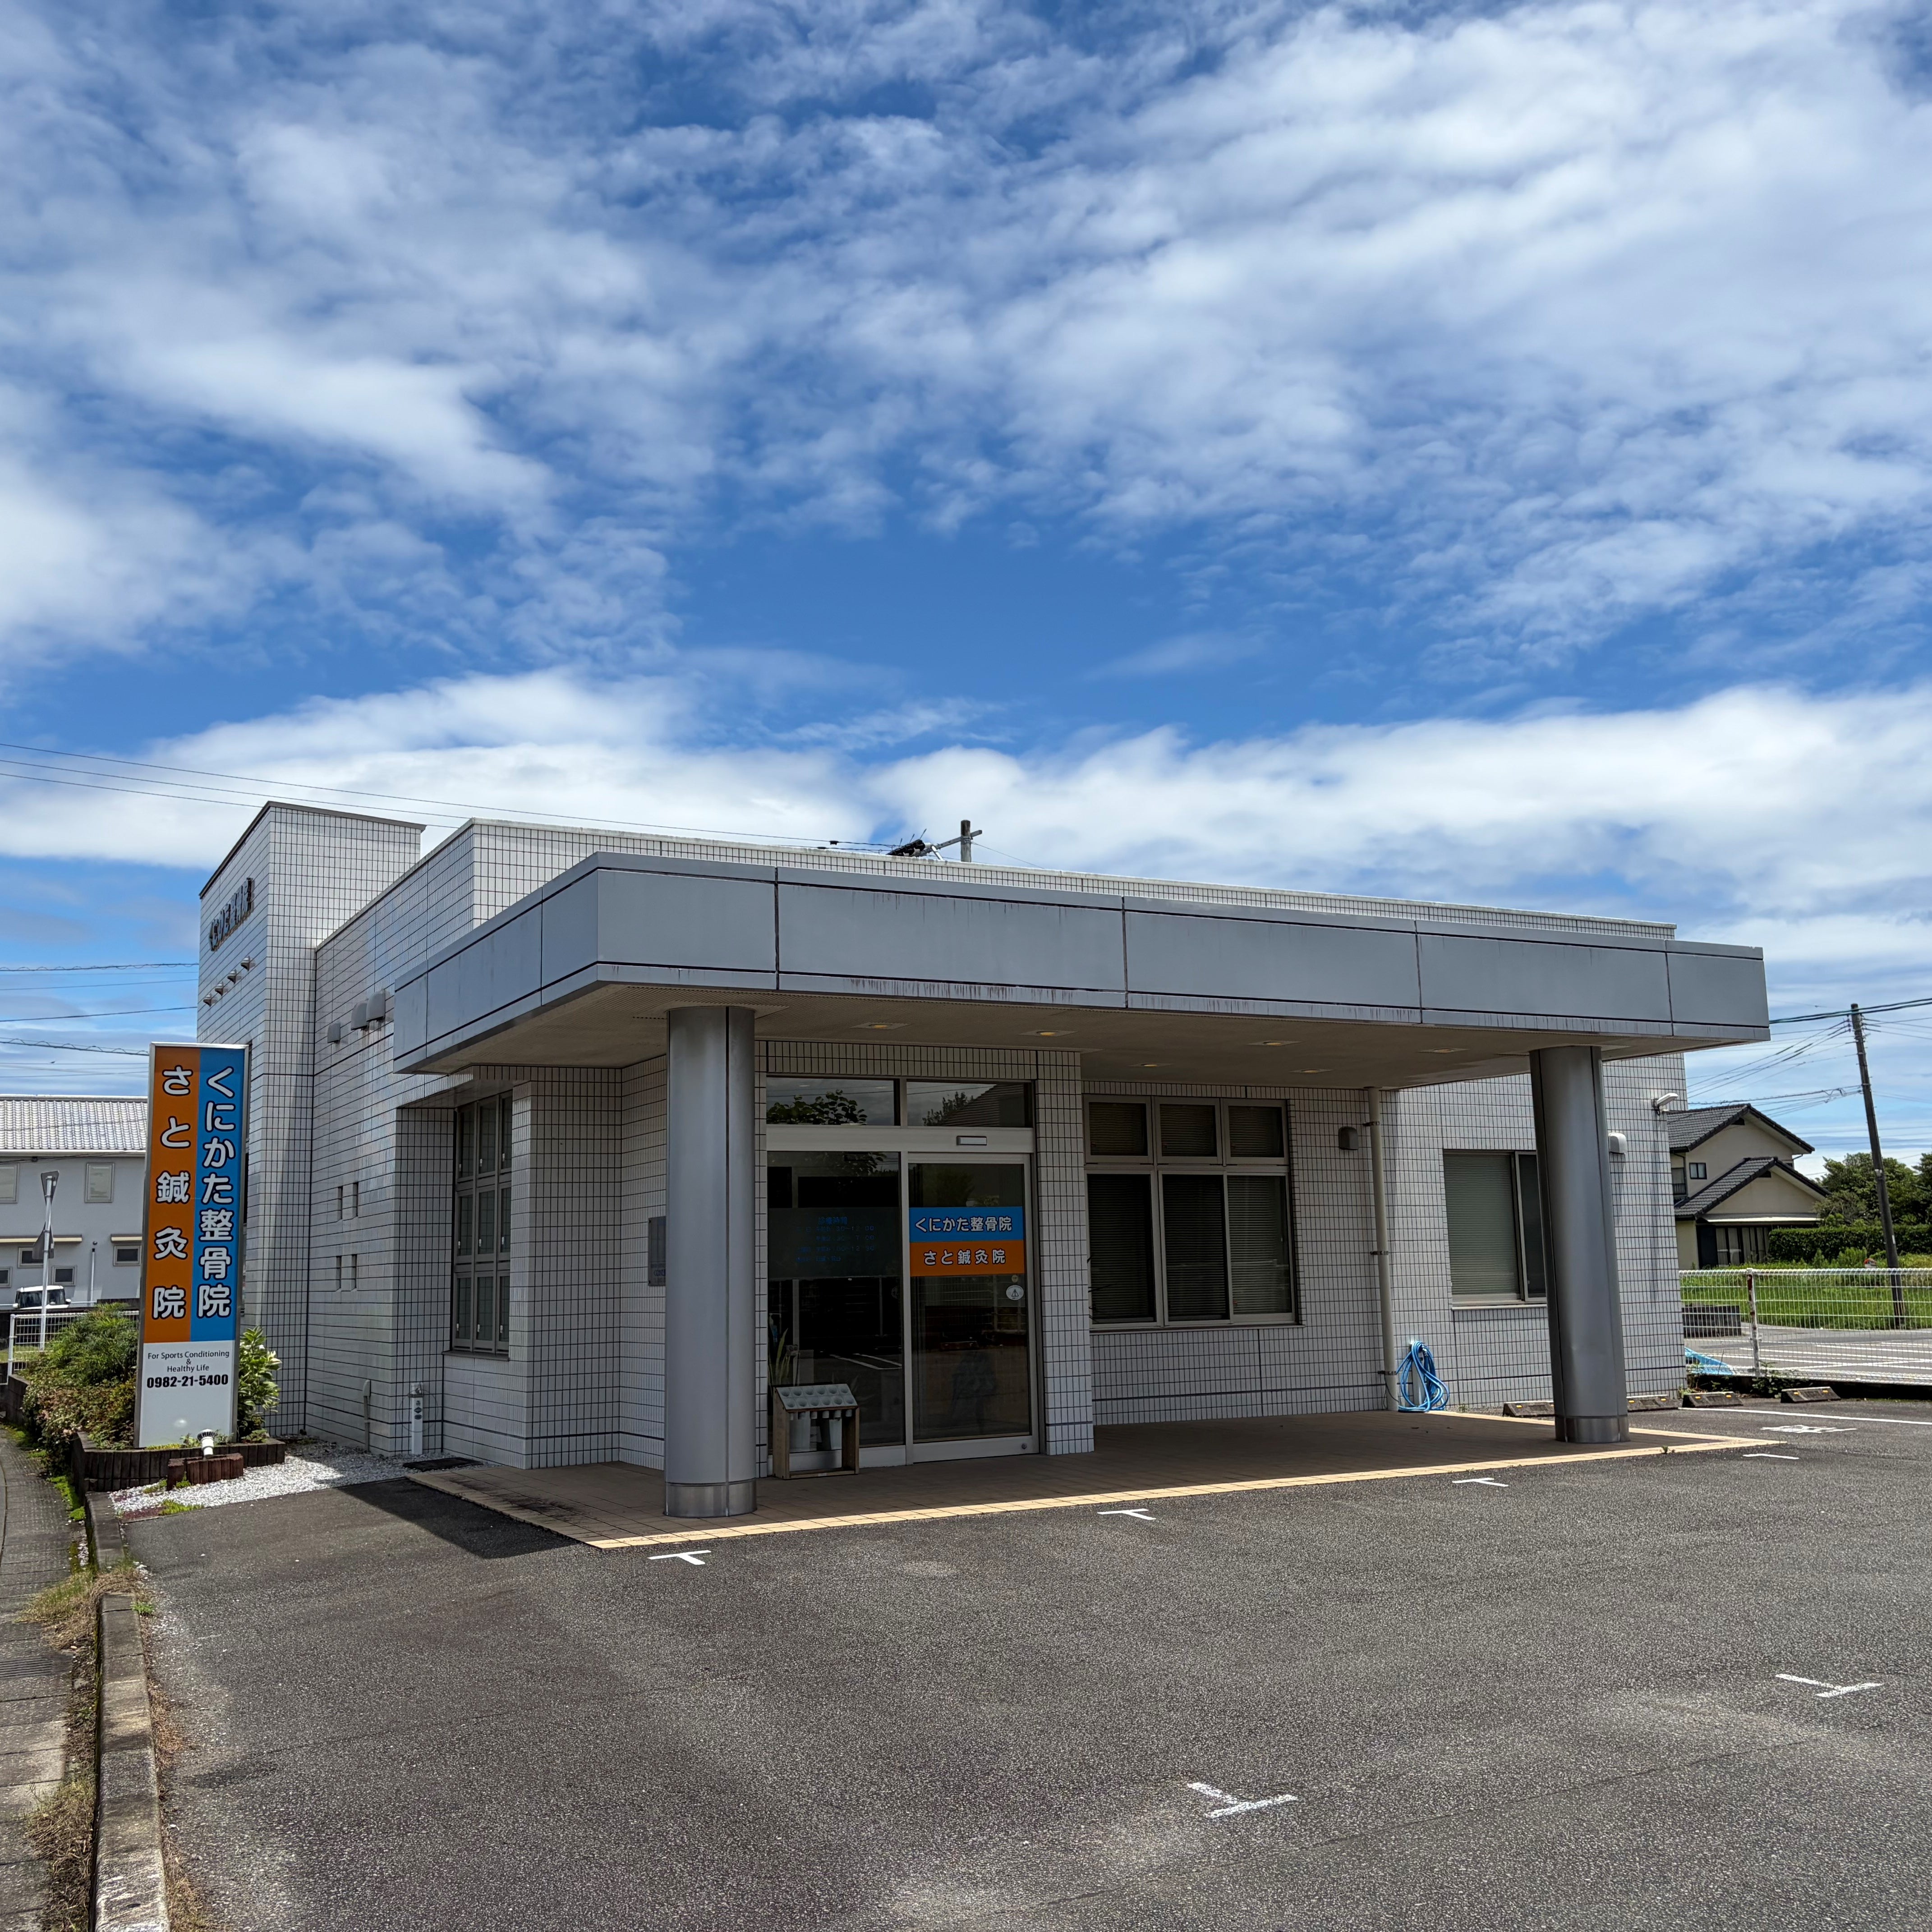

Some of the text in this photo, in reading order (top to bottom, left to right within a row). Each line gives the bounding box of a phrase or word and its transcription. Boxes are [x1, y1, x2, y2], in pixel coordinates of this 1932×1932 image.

[152, 1065, 193, 1319] さと鍼灸院
[198, 1067, 236, 1318] くにかた整骨院
[915, 1216, 1012, 1232] くにかた整骨院
[924, 1249, 1006, 1265] さと鍼灸院
[161, 1352, 183, 1360] Sports
[147, 1374, 229, 1388] 0982-21-5400
